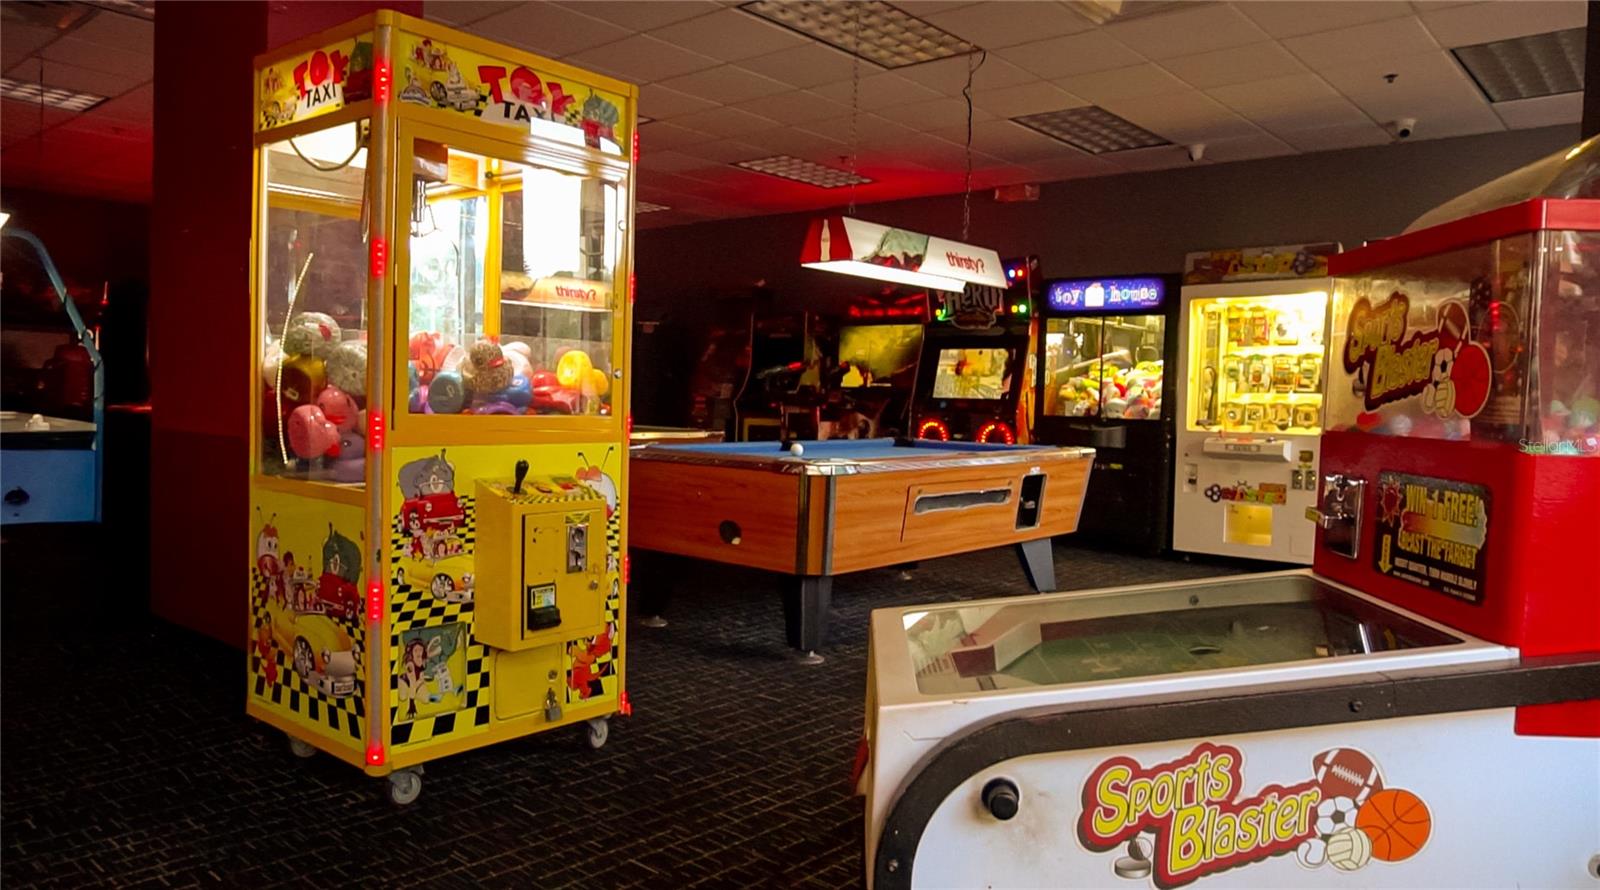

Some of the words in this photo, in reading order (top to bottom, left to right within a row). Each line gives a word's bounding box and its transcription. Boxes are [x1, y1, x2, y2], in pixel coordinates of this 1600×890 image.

[292, 50, 349, 99] TOY
[478, 65, 576, 116] TOY
[304, 81, 337, 109] TAXI
[945, 251, 986, 273] thirsty?
[555, 285, 597, 300] thirsty?
[1054, 286, 1081, 305] toy
[1109, 285, 1158, 303] house
[1094, 751, 1234, 837] Sports
[1170, 788, 1320, 873] Blaster
